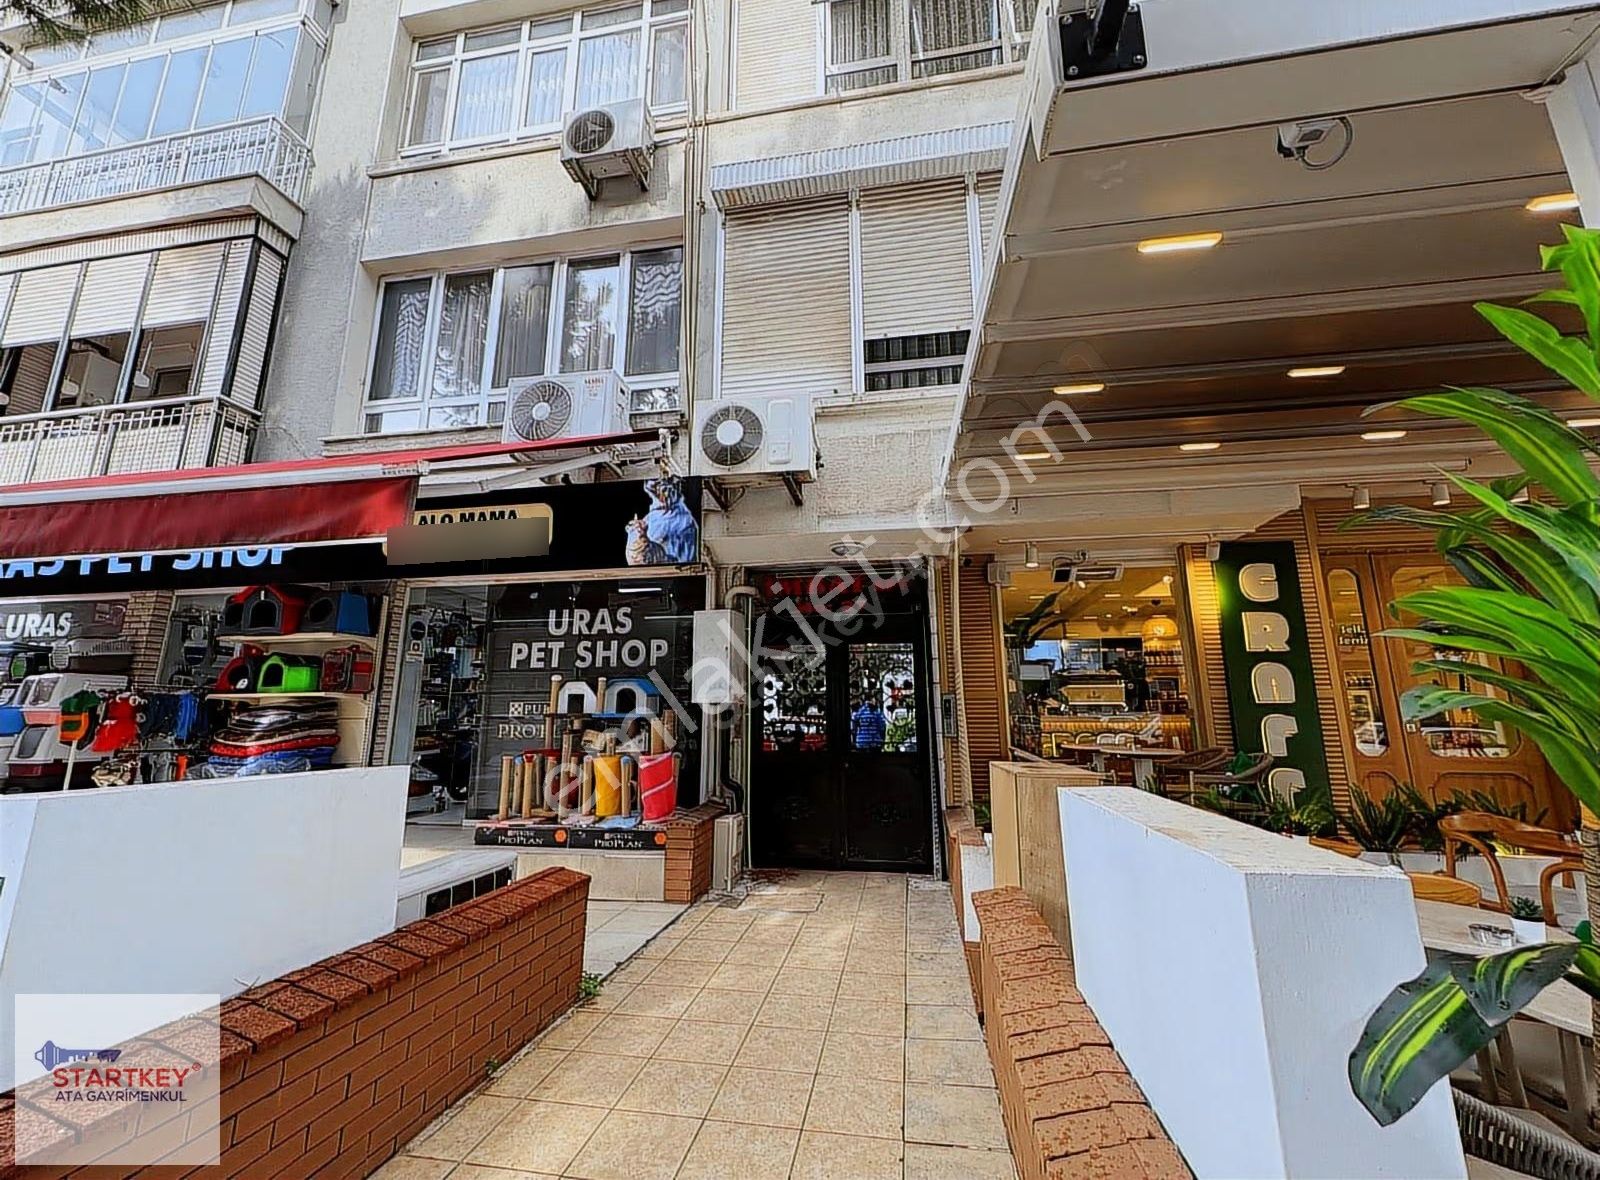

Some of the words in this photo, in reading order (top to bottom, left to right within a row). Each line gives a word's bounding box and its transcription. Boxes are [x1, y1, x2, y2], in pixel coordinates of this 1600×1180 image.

[5, 611, 73, 639] URAS
[548, 606, 633, 637] URAS
[510, 641, 565, 669] PET
[574, 638, 668, 669] SHOP
